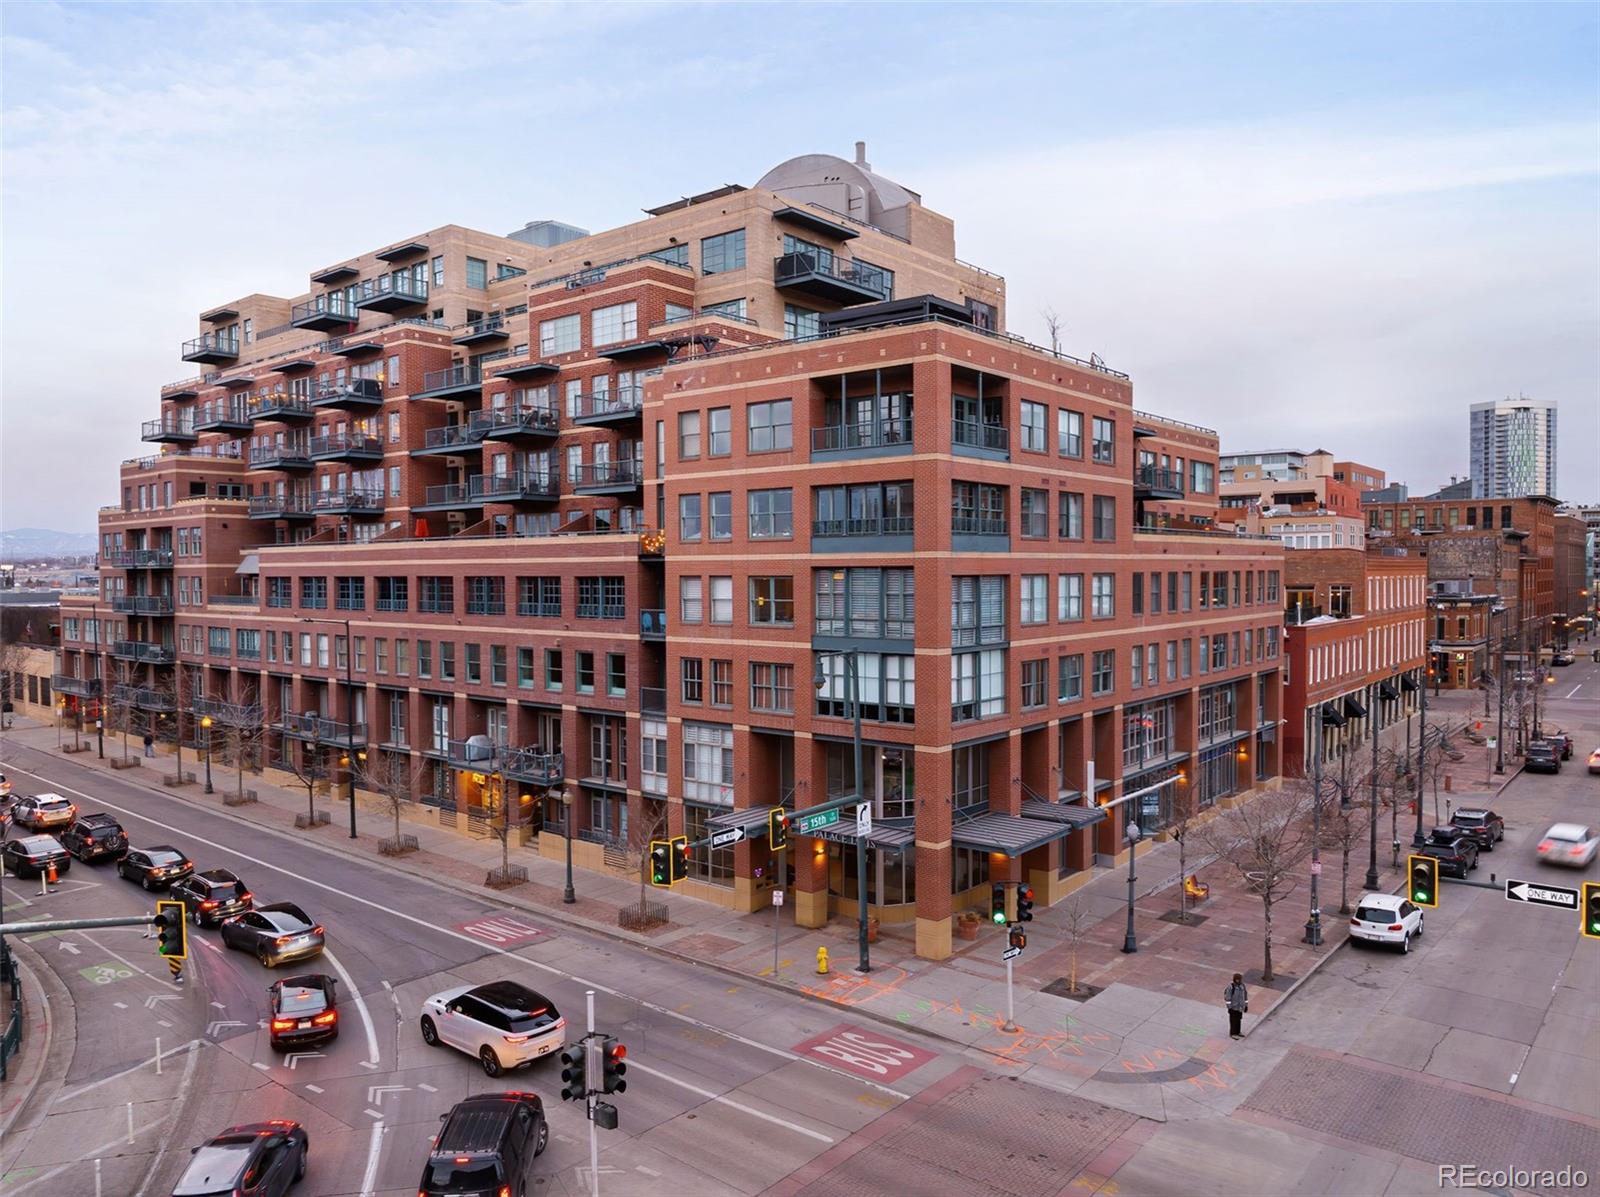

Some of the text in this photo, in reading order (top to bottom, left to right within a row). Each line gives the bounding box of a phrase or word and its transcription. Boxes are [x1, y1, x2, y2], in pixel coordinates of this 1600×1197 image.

[810, 815, 827, 828] 15th
[813, 829, 848, 844] PALACE
[1527, 888, 1570, 903] ONE WAY
[463, 917, 542, 942] ONLY
[811, 1032, 915, 1075] BUS
